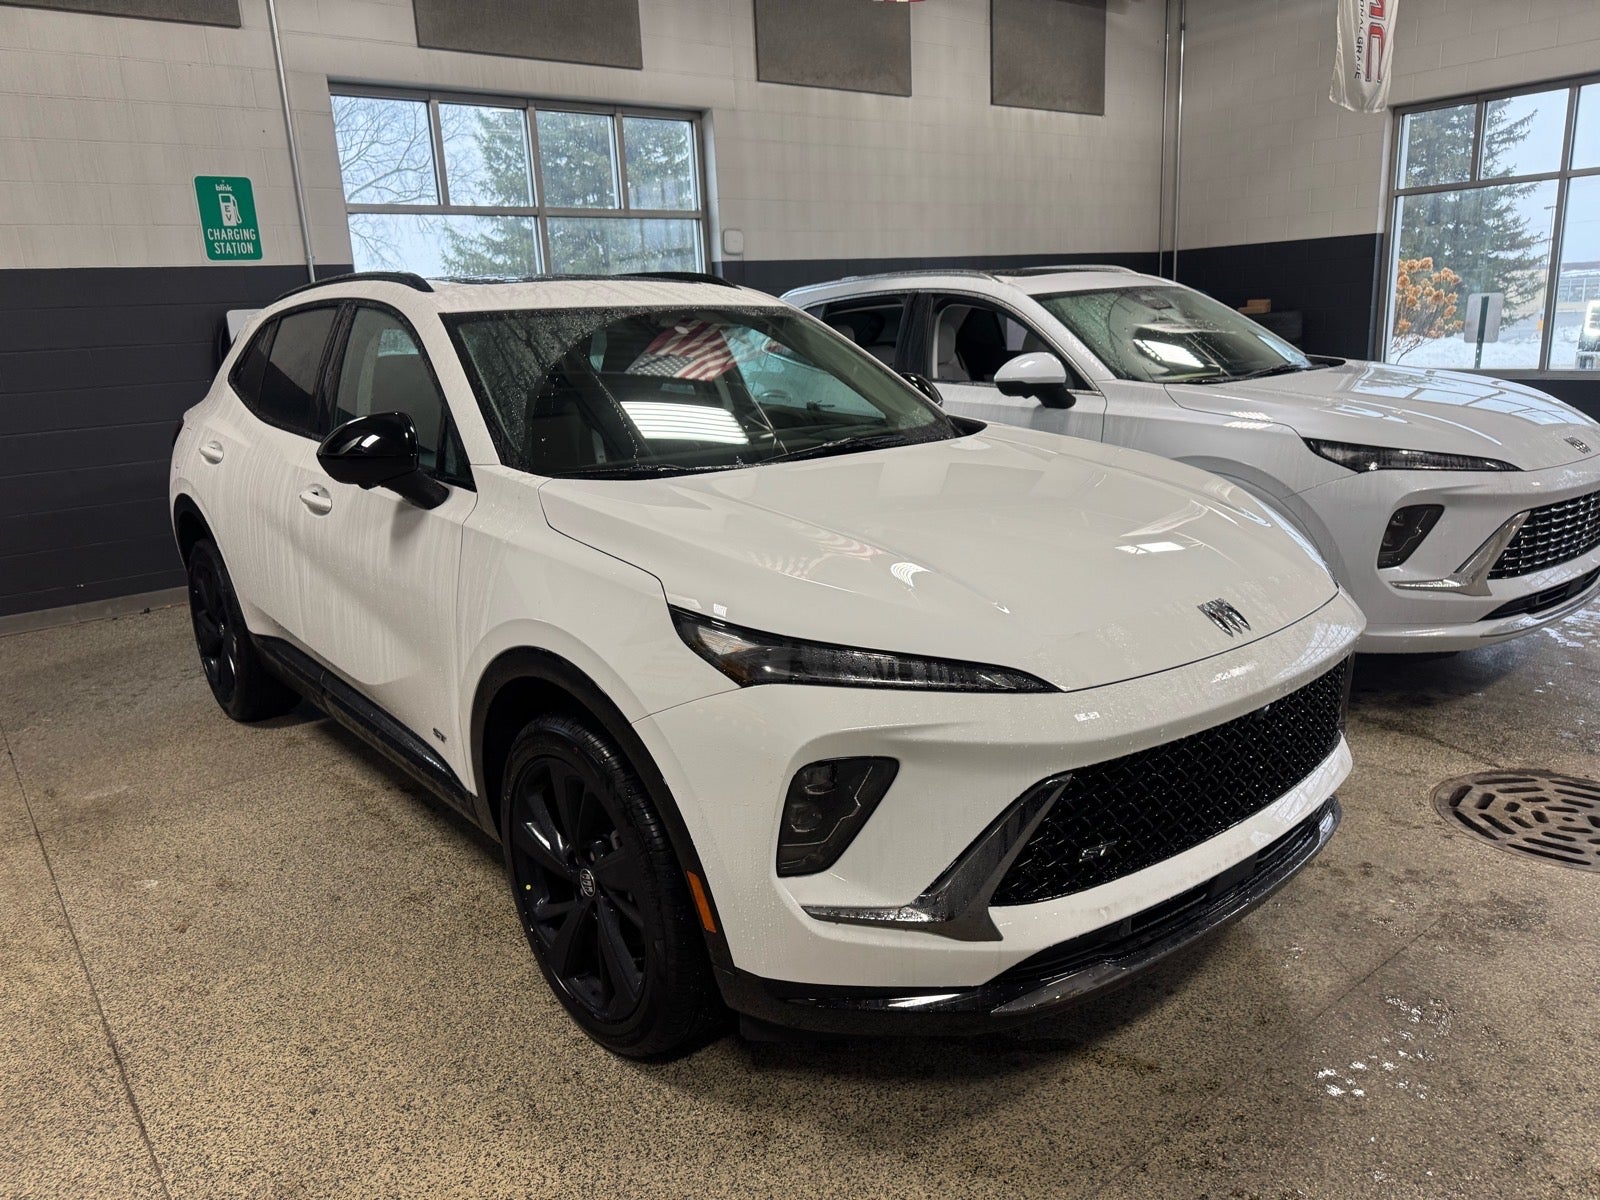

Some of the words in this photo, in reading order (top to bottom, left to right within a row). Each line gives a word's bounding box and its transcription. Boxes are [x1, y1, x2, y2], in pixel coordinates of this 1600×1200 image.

[1354, 36, 1364, 80] GRADE
[215, 183, 233, 192] blink
[207, 228, 257, 241] CHARGING
[214, 241, 254, 256] STATION
